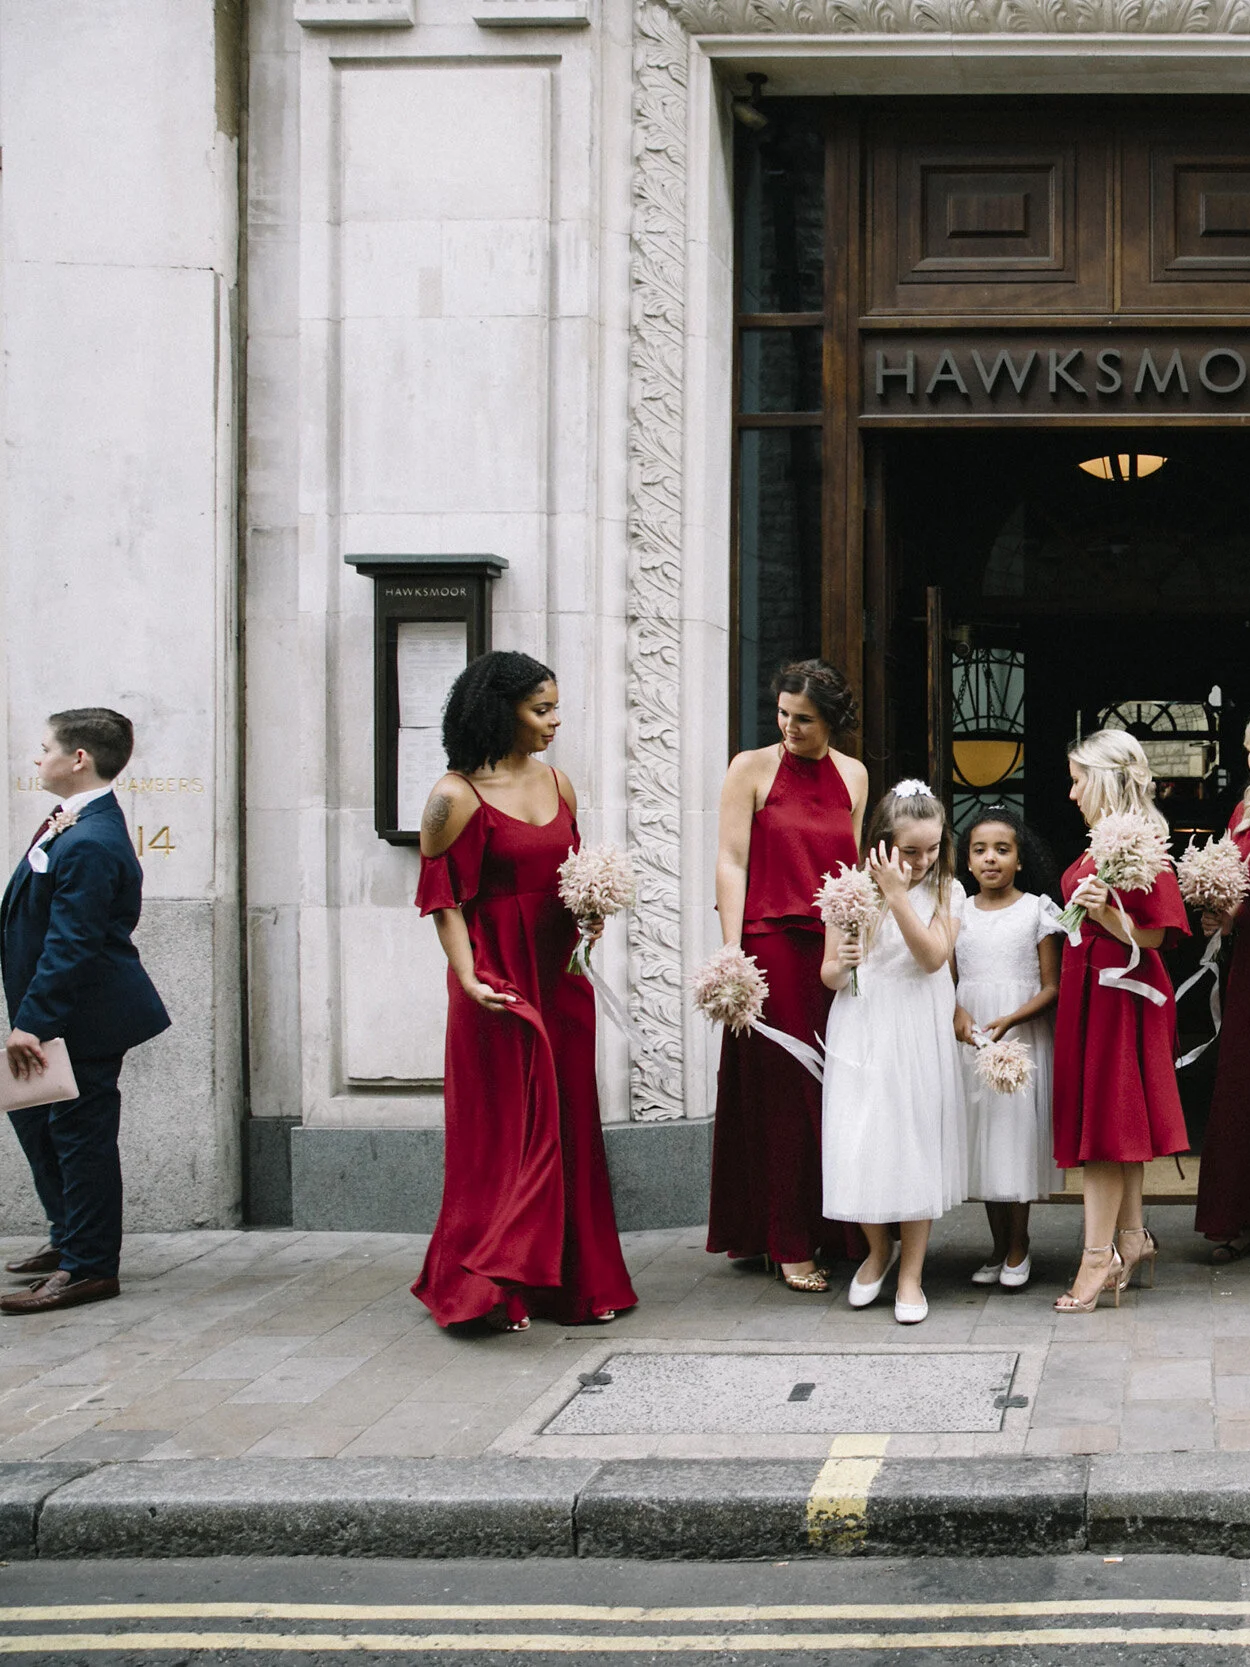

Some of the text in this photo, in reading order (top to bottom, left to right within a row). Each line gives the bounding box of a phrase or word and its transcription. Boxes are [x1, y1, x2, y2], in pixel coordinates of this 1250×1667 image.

[385, 587, 467, 597] HAWKSMOOR
[115, 776, 205, 793] HAMBERS
[137, 825, 176, 858] 14
